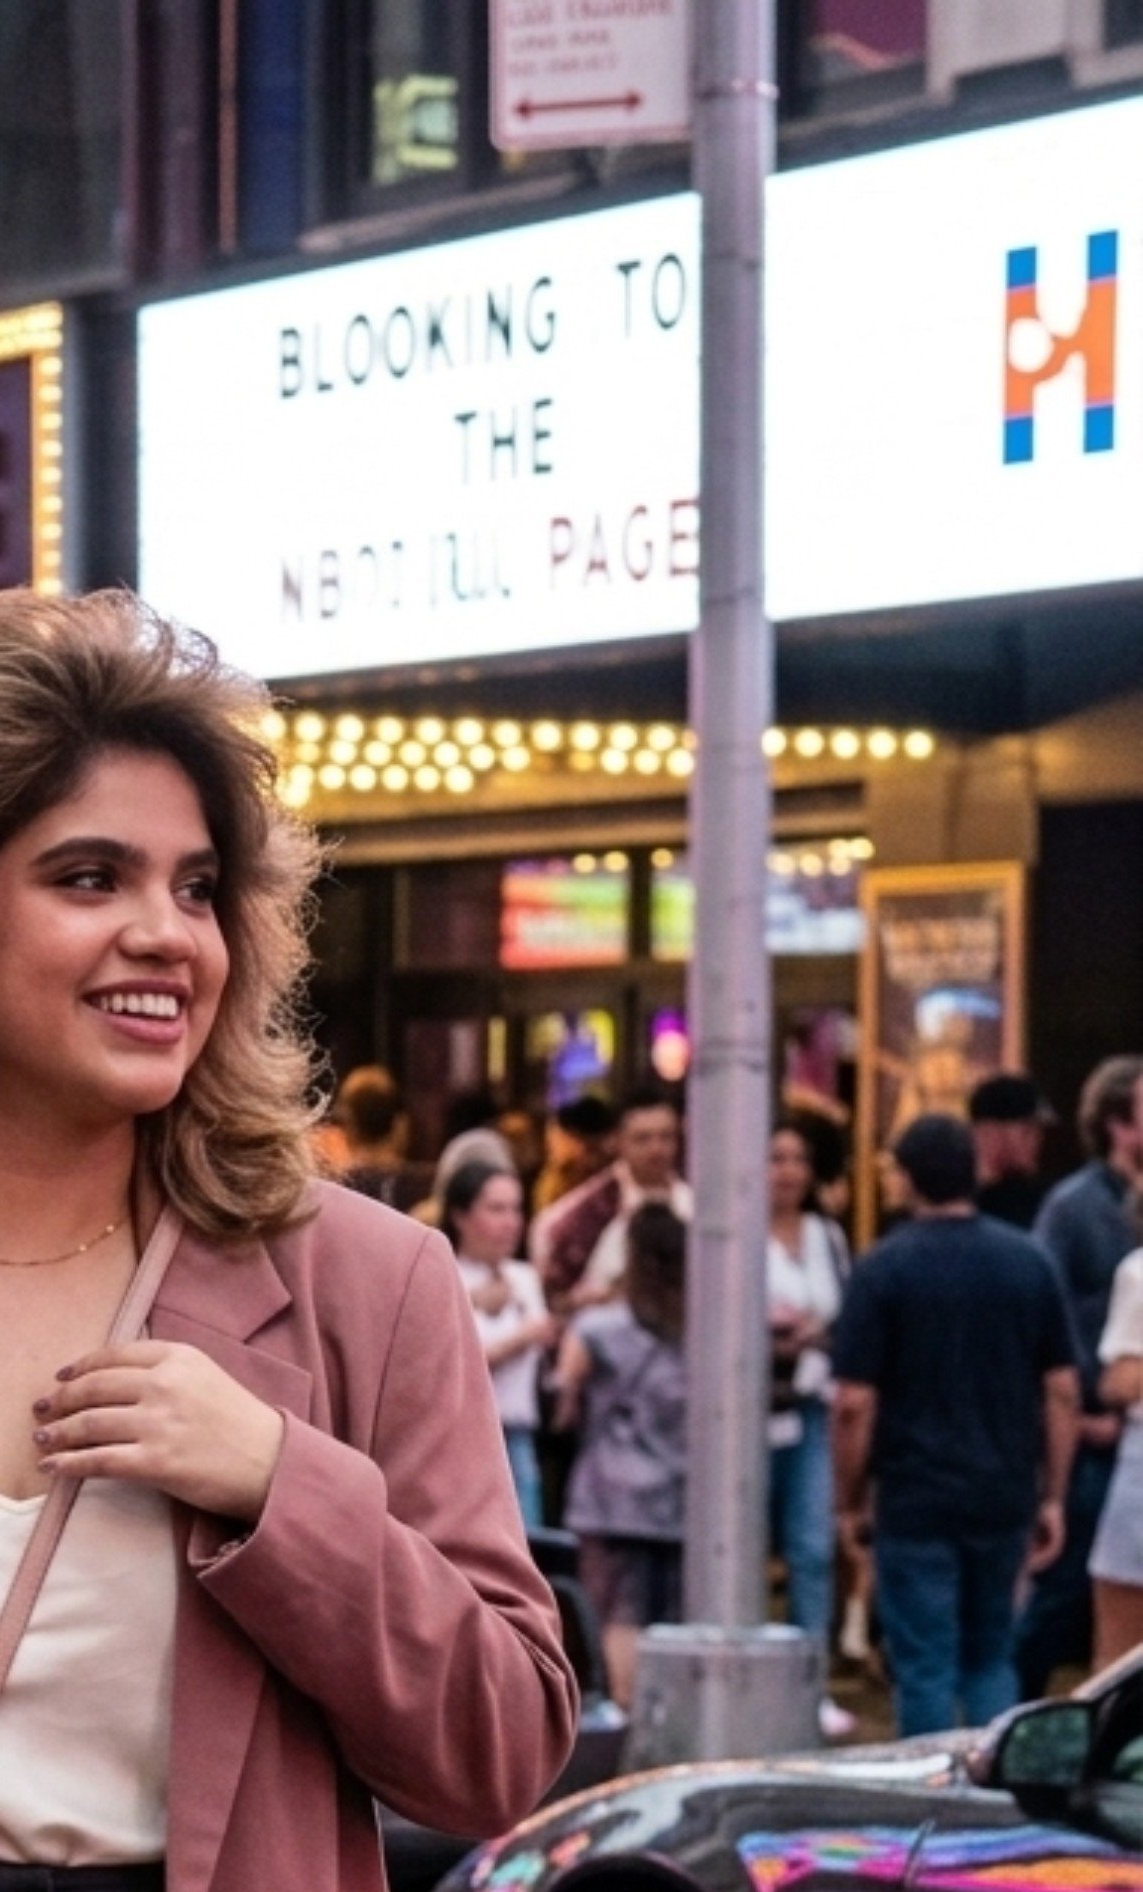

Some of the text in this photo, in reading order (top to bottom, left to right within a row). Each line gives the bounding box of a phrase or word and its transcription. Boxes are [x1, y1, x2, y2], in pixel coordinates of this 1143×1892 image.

[278, 252, 687, 399] BLOOKING TO
[454, 398, 553, 486] THE
[550, 497, 700, 590] PAGE
